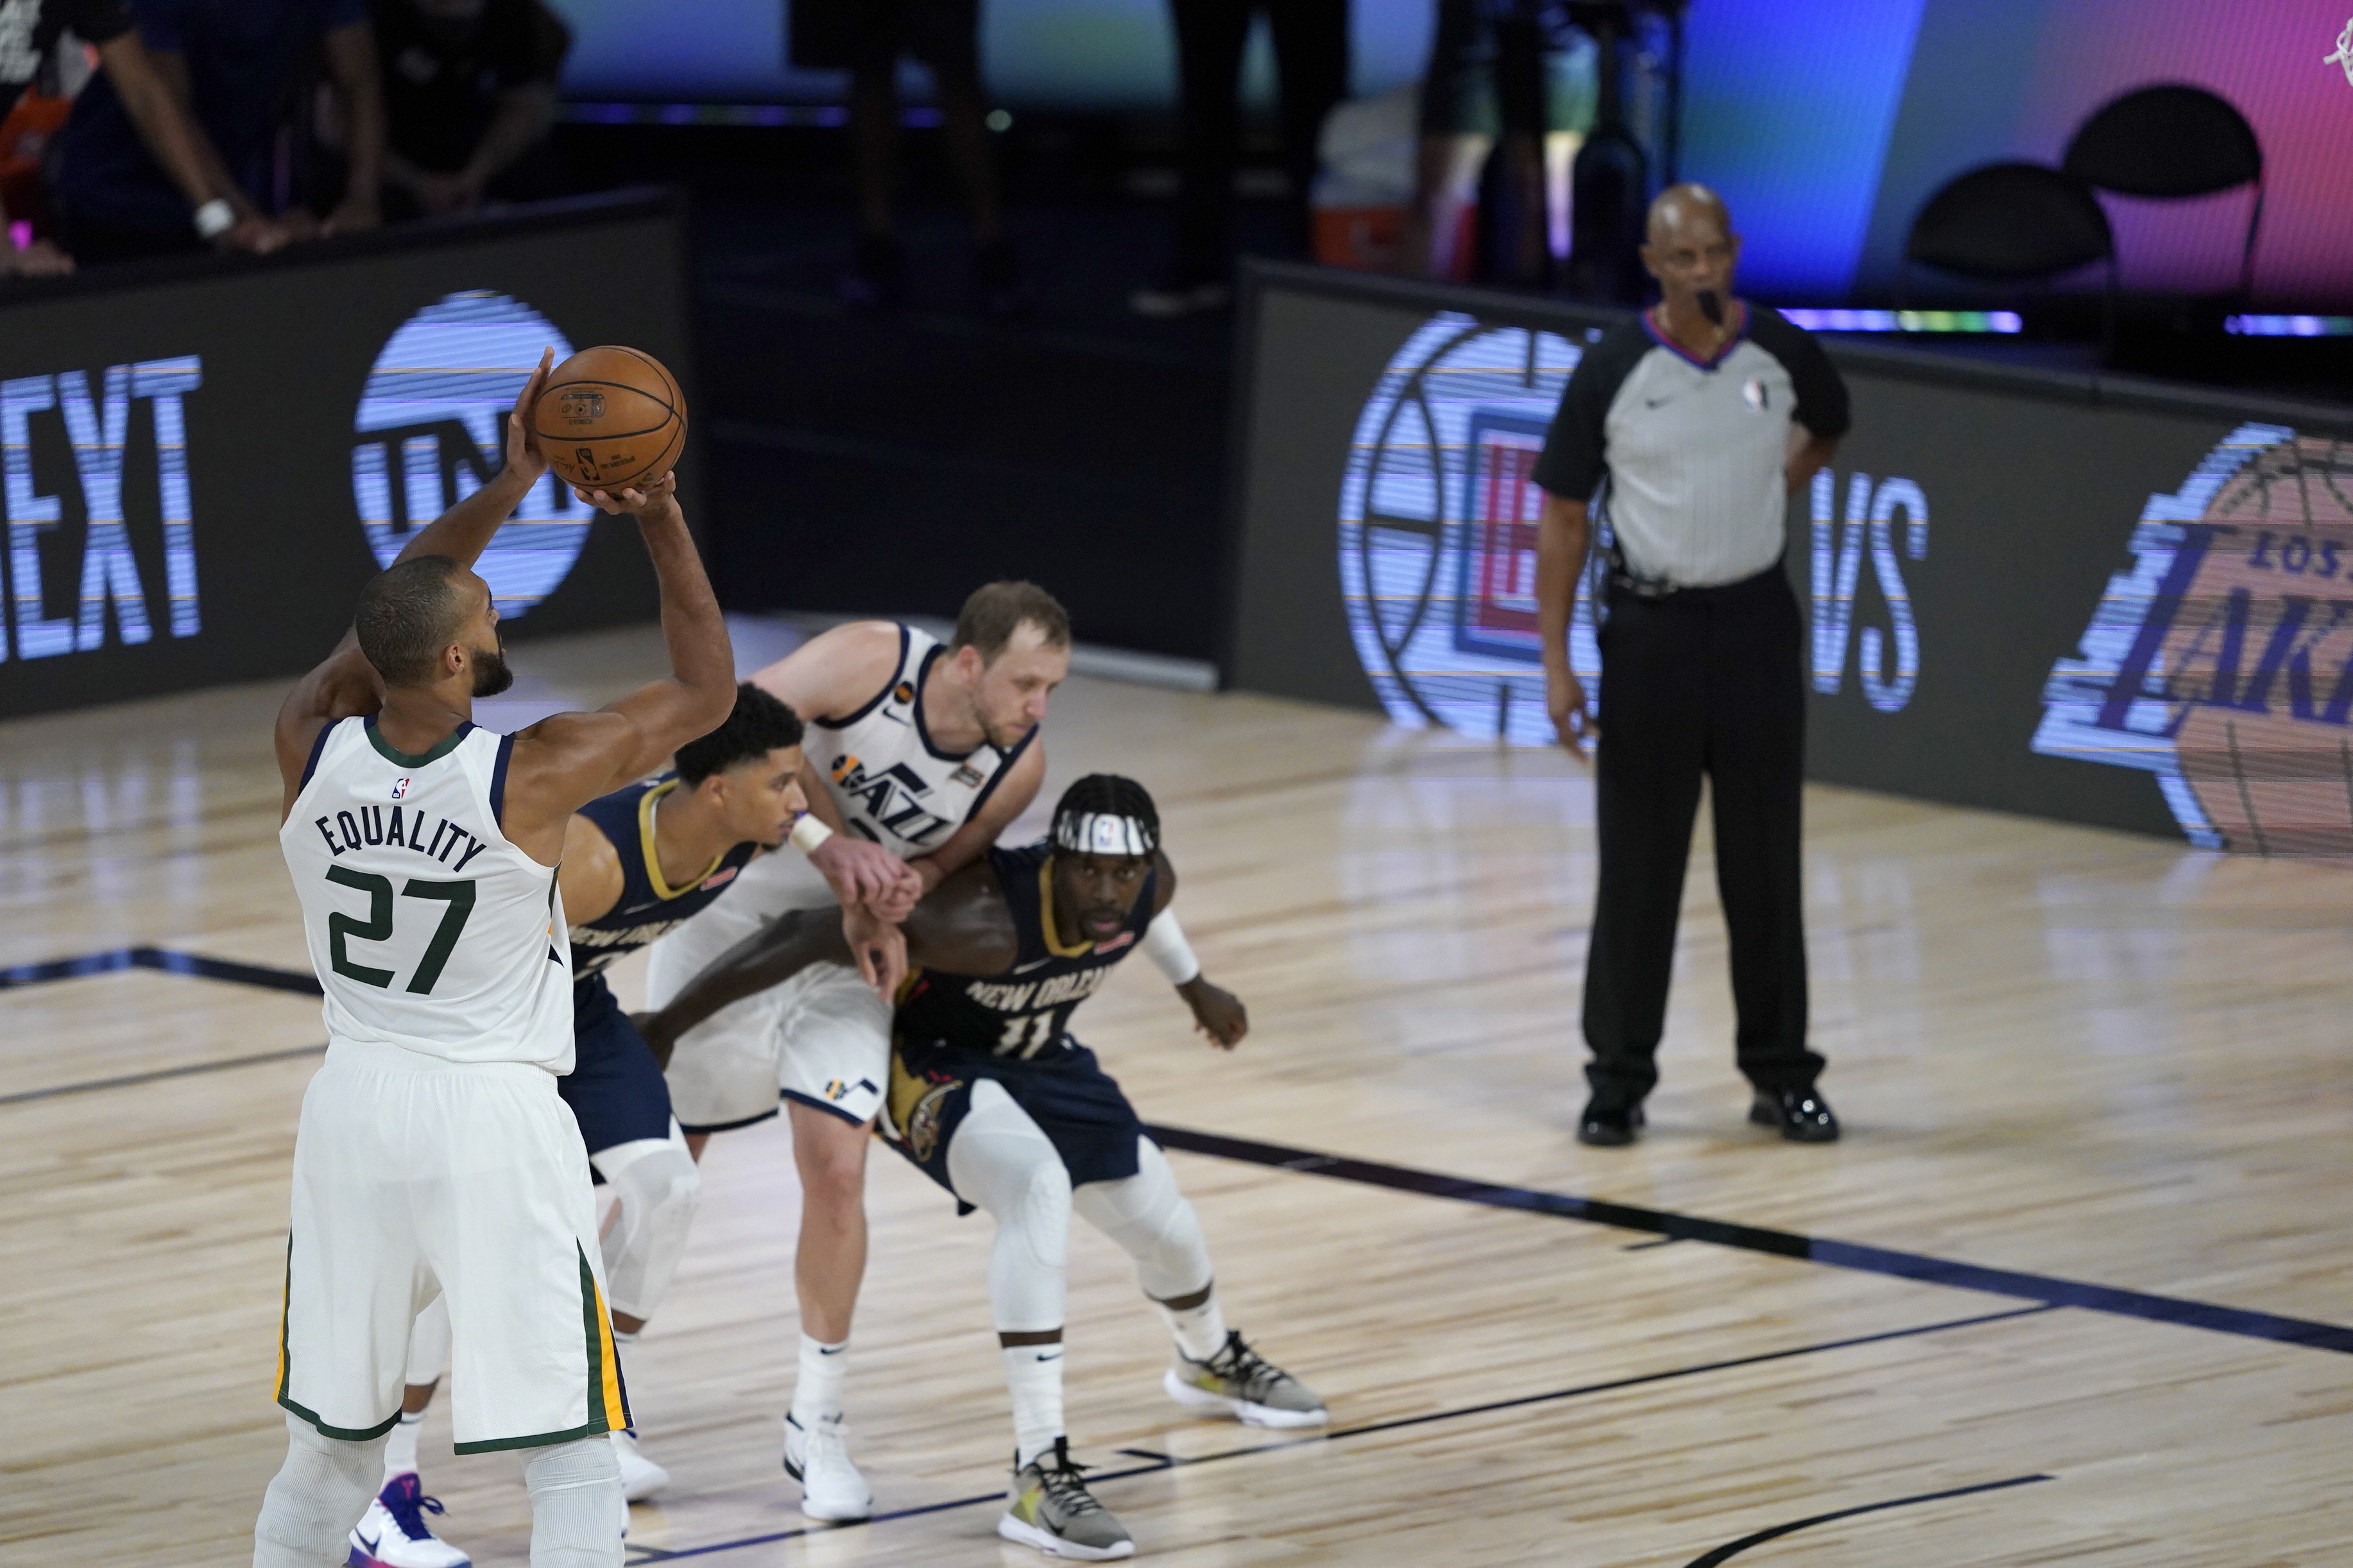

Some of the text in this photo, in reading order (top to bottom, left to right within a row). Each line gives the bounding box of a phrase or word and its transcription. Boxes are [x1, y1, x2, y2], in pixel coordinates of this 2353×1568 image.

[0, 354, 203, 665] EXT
[2248, 530, 2346, 579] LOS
[1810, 466, 1929, 713] VS
[2067, 520, 2353, 738] LAK
[315, 805, 487, 873] EQUALITY
[325, 864, 476, 995] 27
[965, 964, 1115, 1012] NEW ORLE
[993, 1009, 1056, 1060] 11
